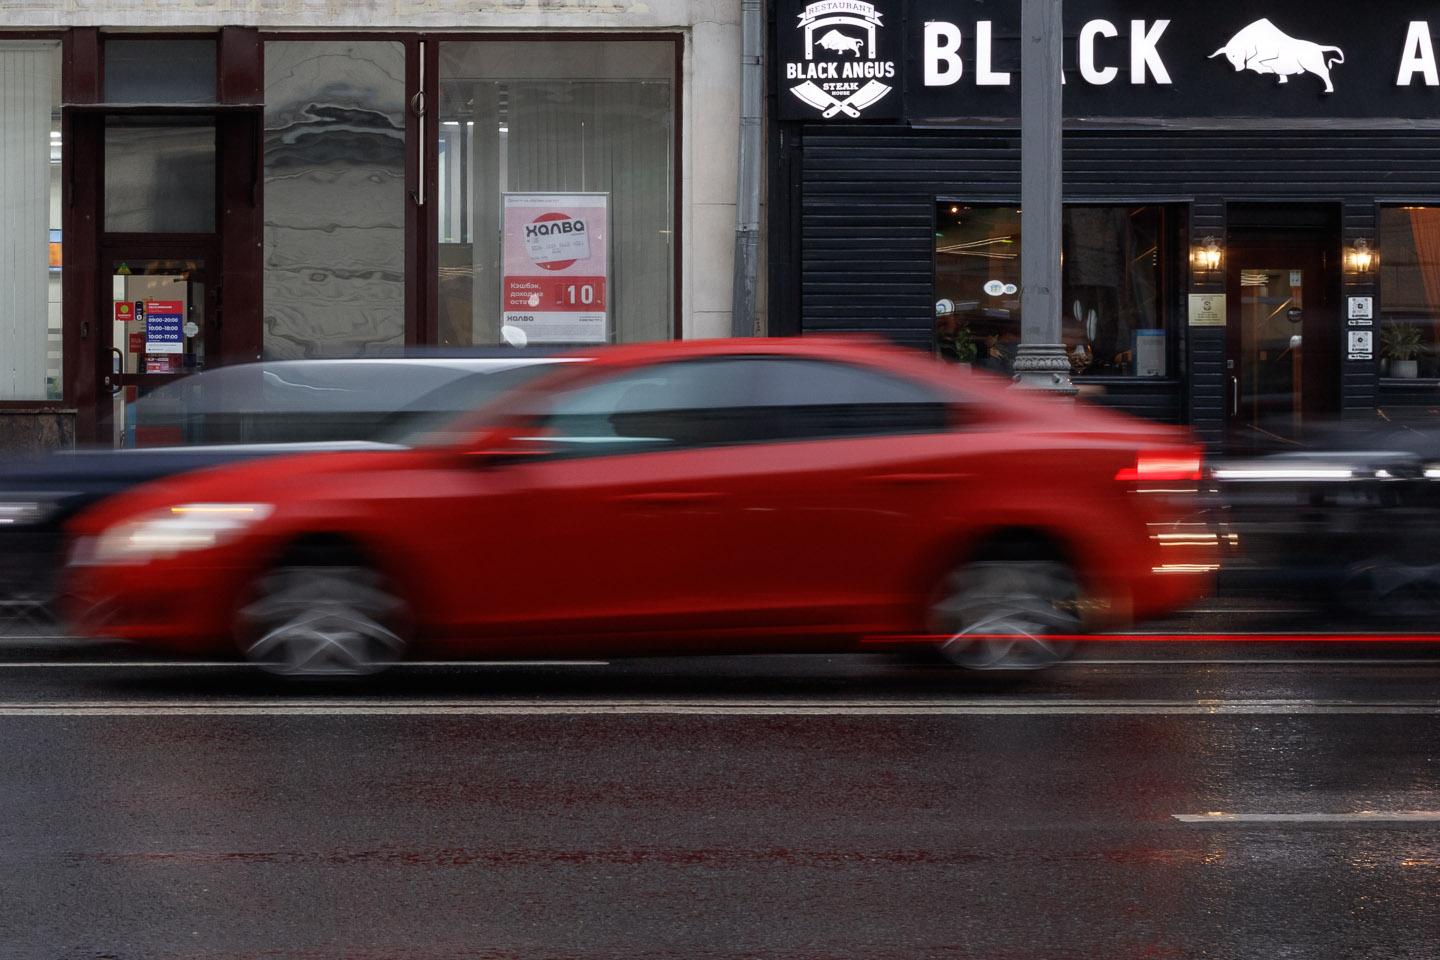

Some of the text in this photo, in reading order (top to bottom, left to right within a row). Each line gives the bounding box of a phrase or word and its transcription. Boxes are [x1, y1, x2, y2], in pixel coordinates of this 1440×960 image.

[808, 1, 873, 15] RESTAURANT
[923, 18, 1173, 87] BLCK
[786, 61, 895, 79] BLACK ANGUS
[823, 82, 859, 90] STEAK
